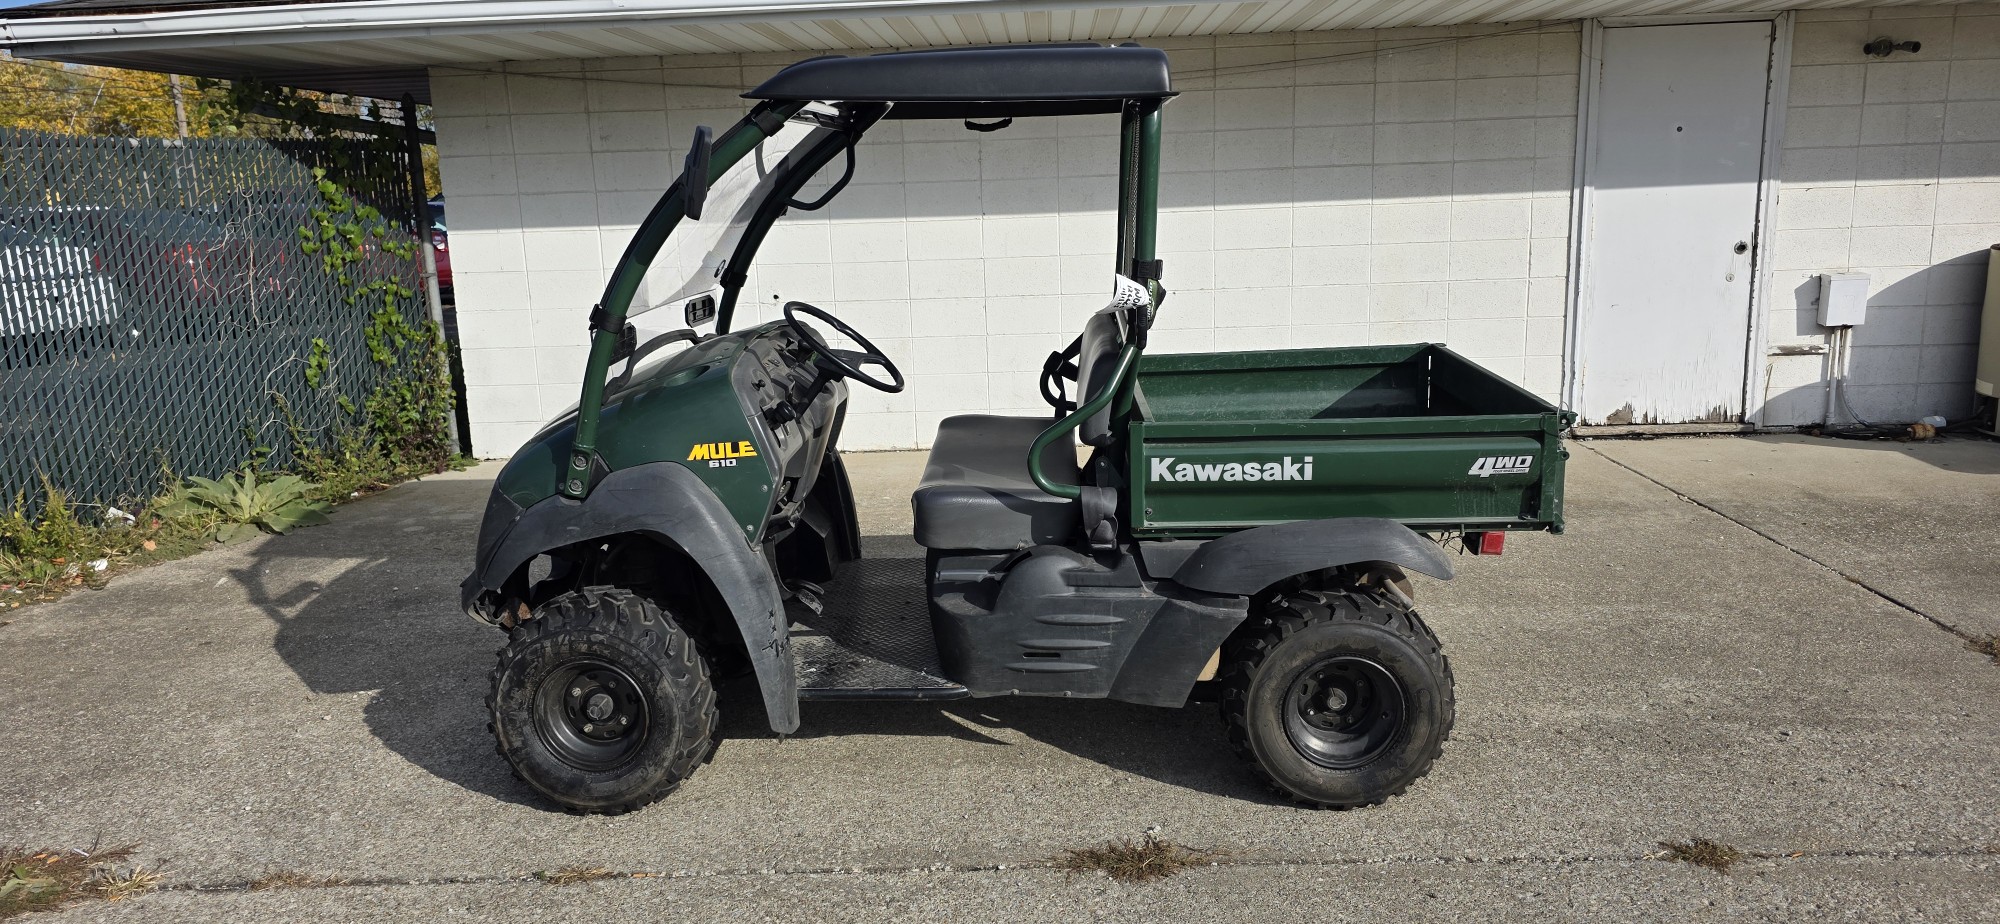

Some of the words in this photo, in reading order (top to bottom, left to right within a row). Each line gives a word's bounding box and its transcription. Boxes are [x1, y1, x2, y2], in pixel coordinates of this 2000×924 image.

[686, 440, 758, 461] MULE
[708, 458, 737, 468] 610
[1150, 456, 1313, 482] Kawasaki
[1467, 455, 1534, 478] 4WD
